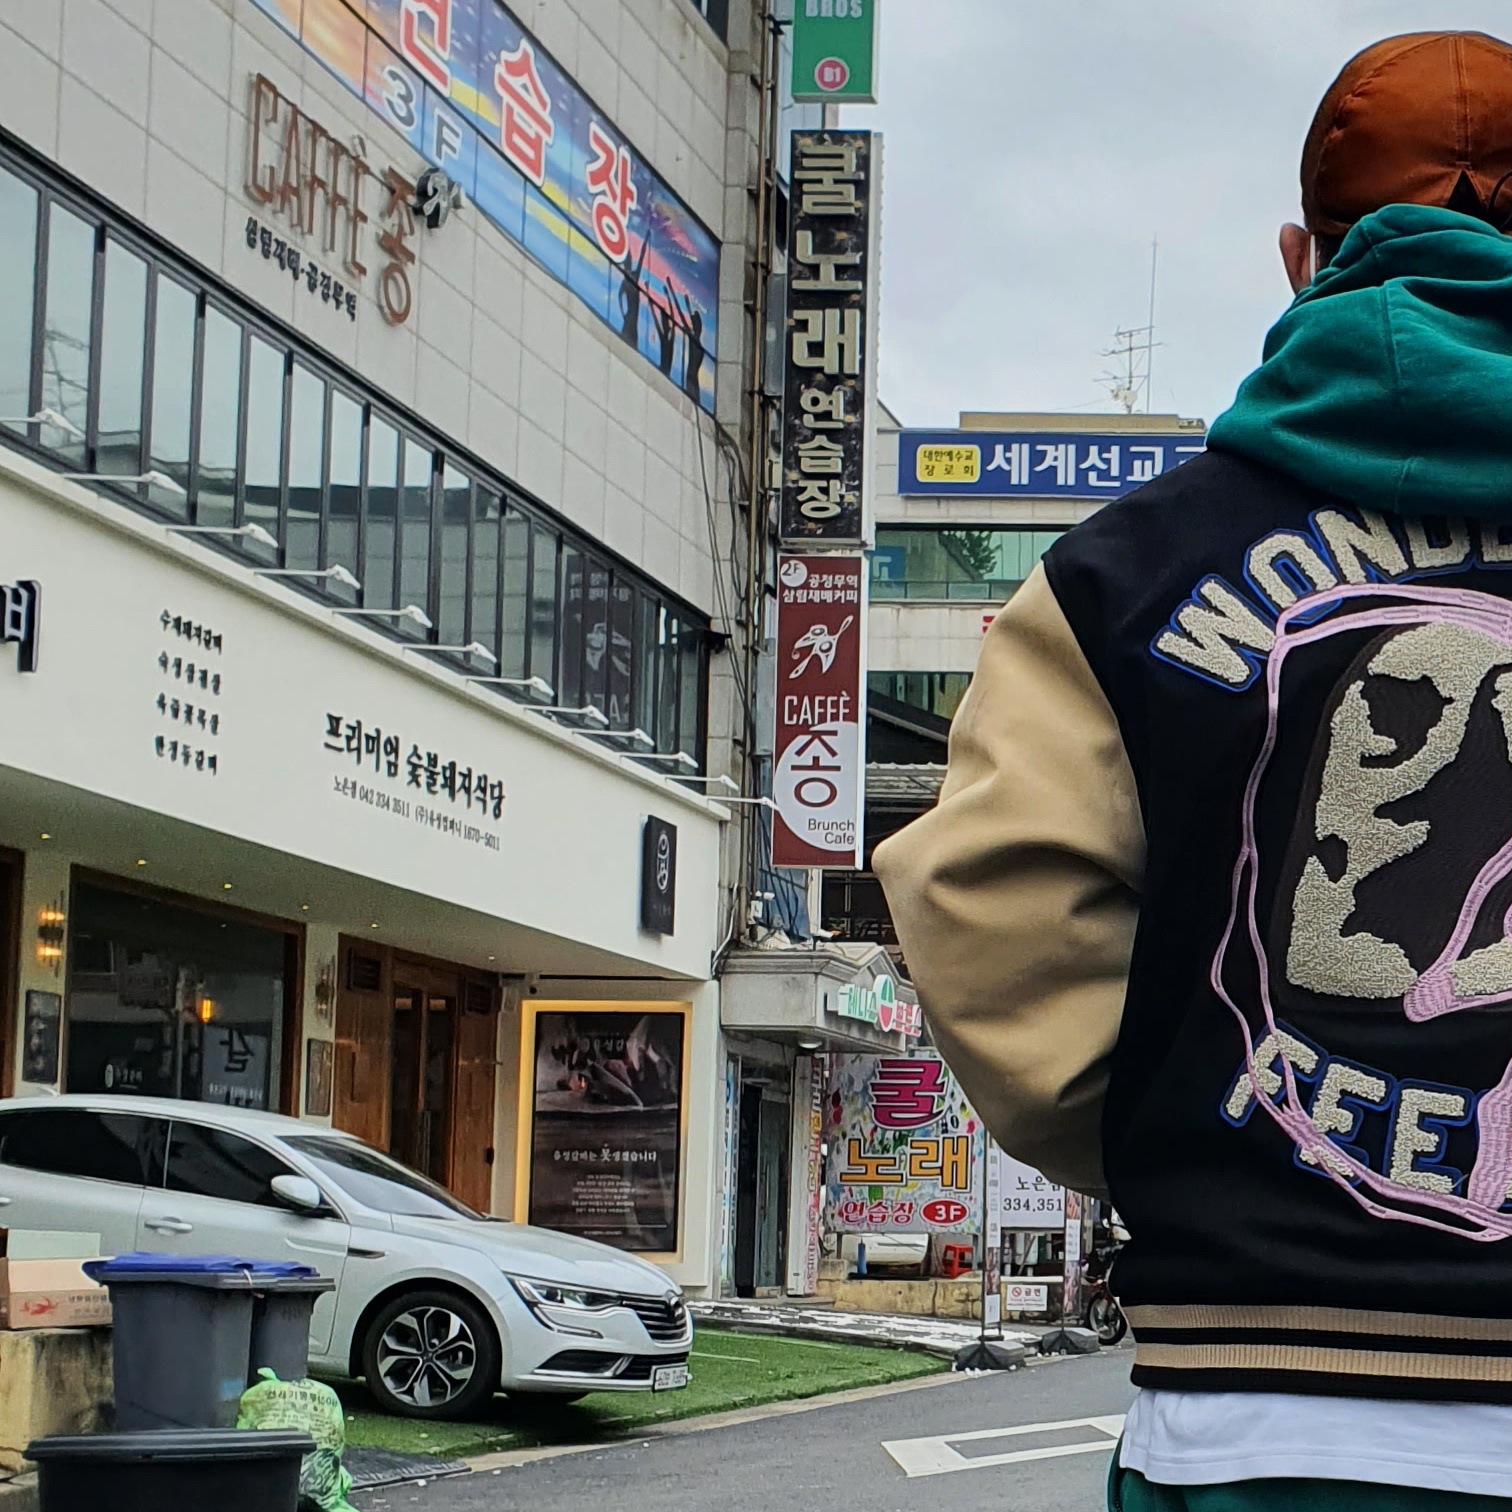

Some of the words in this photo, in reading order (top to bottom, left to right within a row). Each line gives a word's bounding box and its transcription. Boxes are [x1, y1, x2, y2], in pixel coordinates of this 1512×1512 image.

[823, 67, 841, 82] B1
[383, 66, 462, 168] 3F
[985, 442, 1208, 488] 세계선교
[781, 562, 801, 577] 2F
[809, 574, 858, 589] 공정무역
[782, 588, 858, 604] 삼림재배커피
[784, 690, 851, 725] CAFFÈ
[323, 712, 400, 778] 프리미엄
[406, 743, 506, 821] 숯불돼지식당
[808, 818, 855, 831] Brunch
[824, 832, 855, 845] Cafe
[868, 1058, 949, 1130] 쿨
[839, 1135, 970, 1191] 노래
[842, 1200, 915, 1227] 연습장
[933, 1204, 964, 1221] 3F
